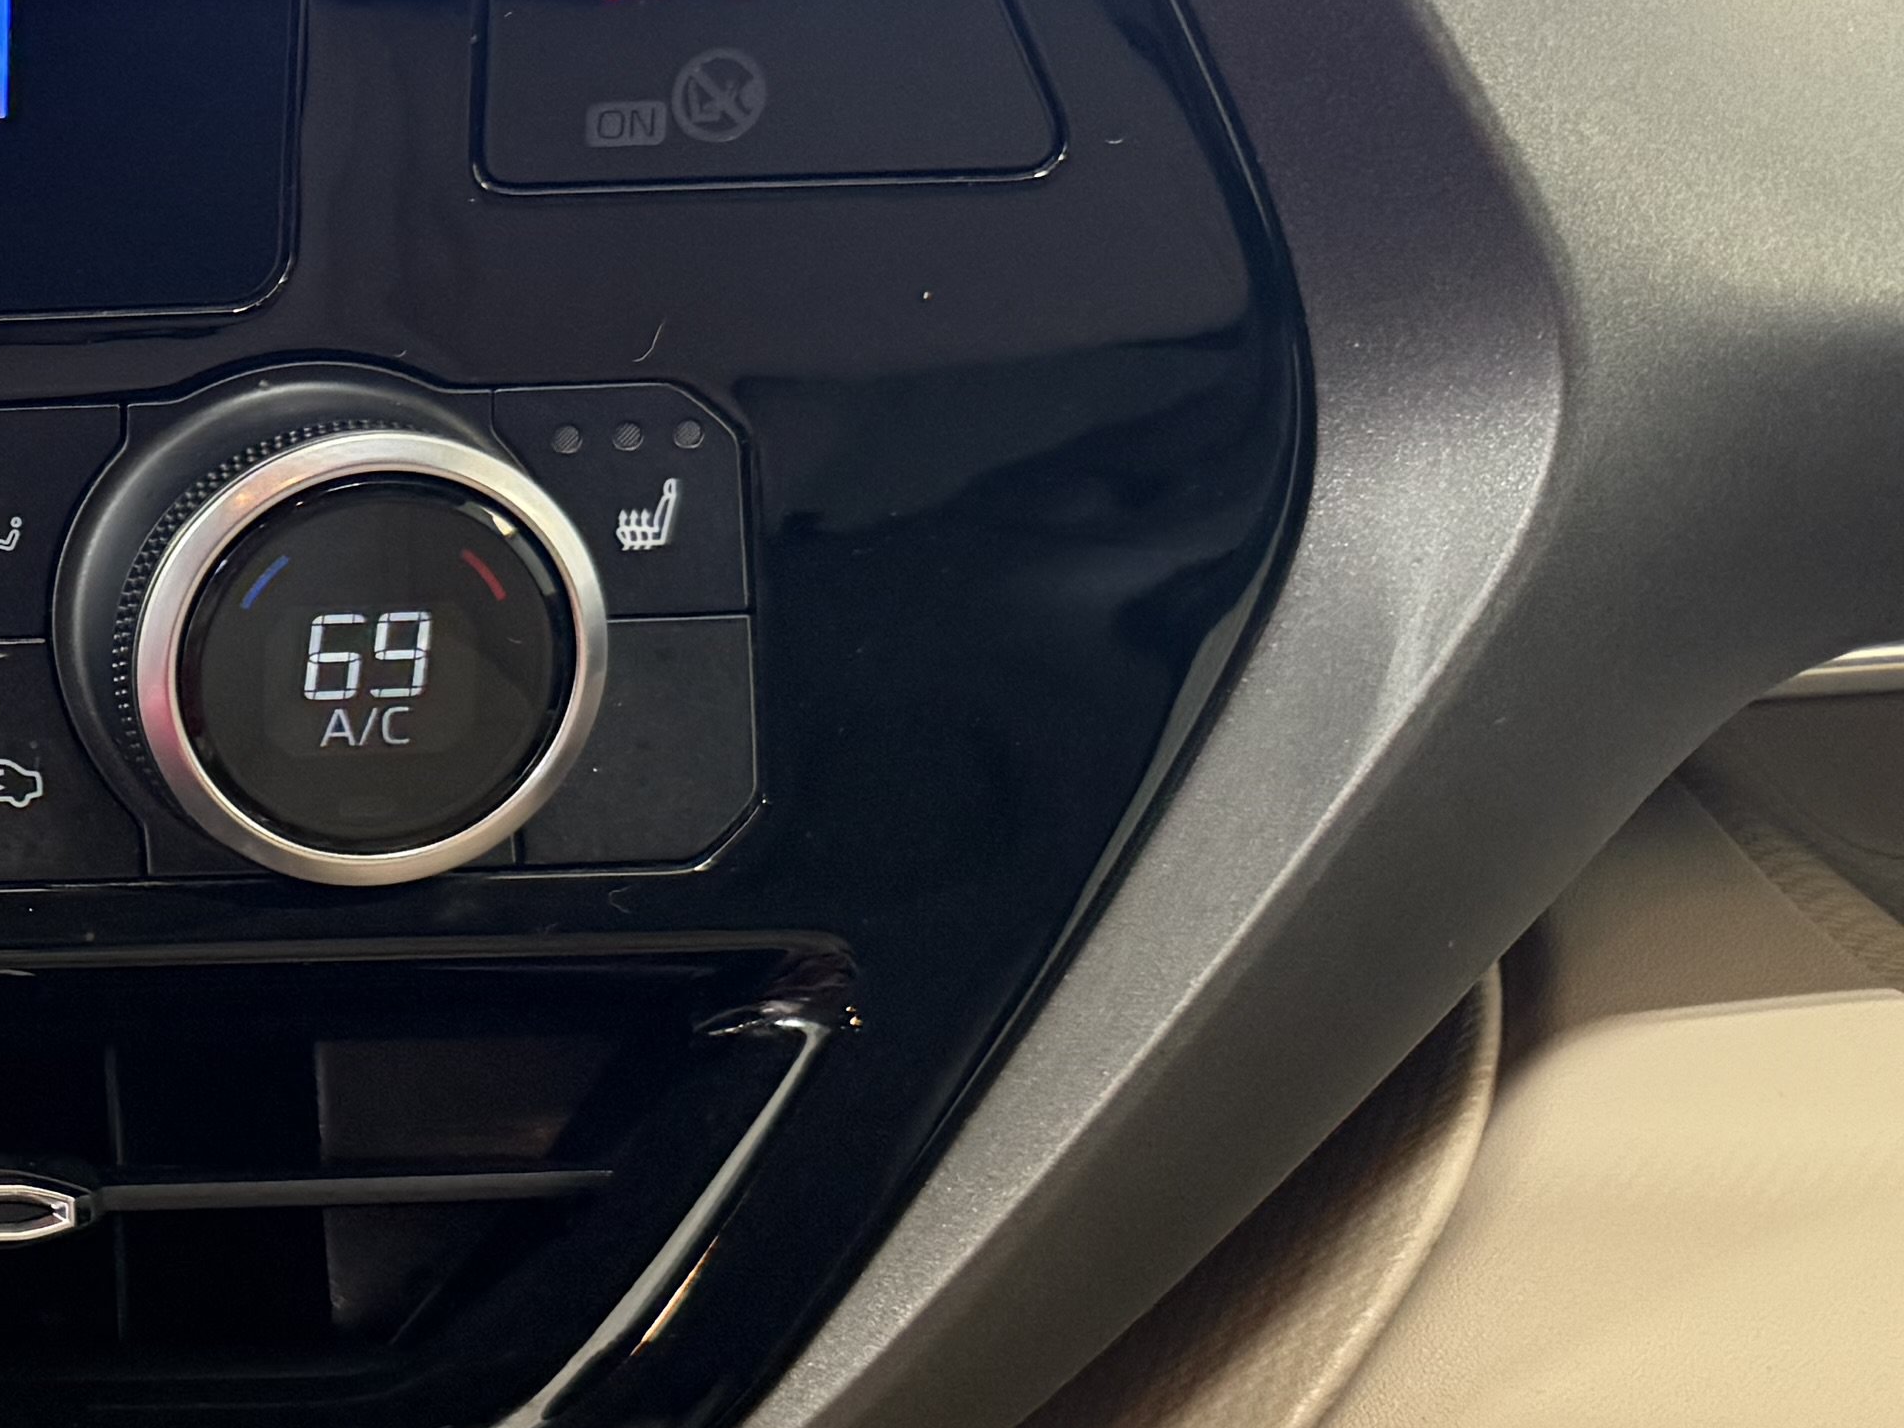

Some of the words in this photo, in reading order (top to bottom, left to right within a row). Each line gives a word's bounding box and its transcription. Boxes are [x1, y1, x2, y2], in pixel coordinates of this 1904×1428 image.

[596, 107, 656, 140] ON
[302, 609, 433, 701] 69
[320, 705, 411, 749] A/C
